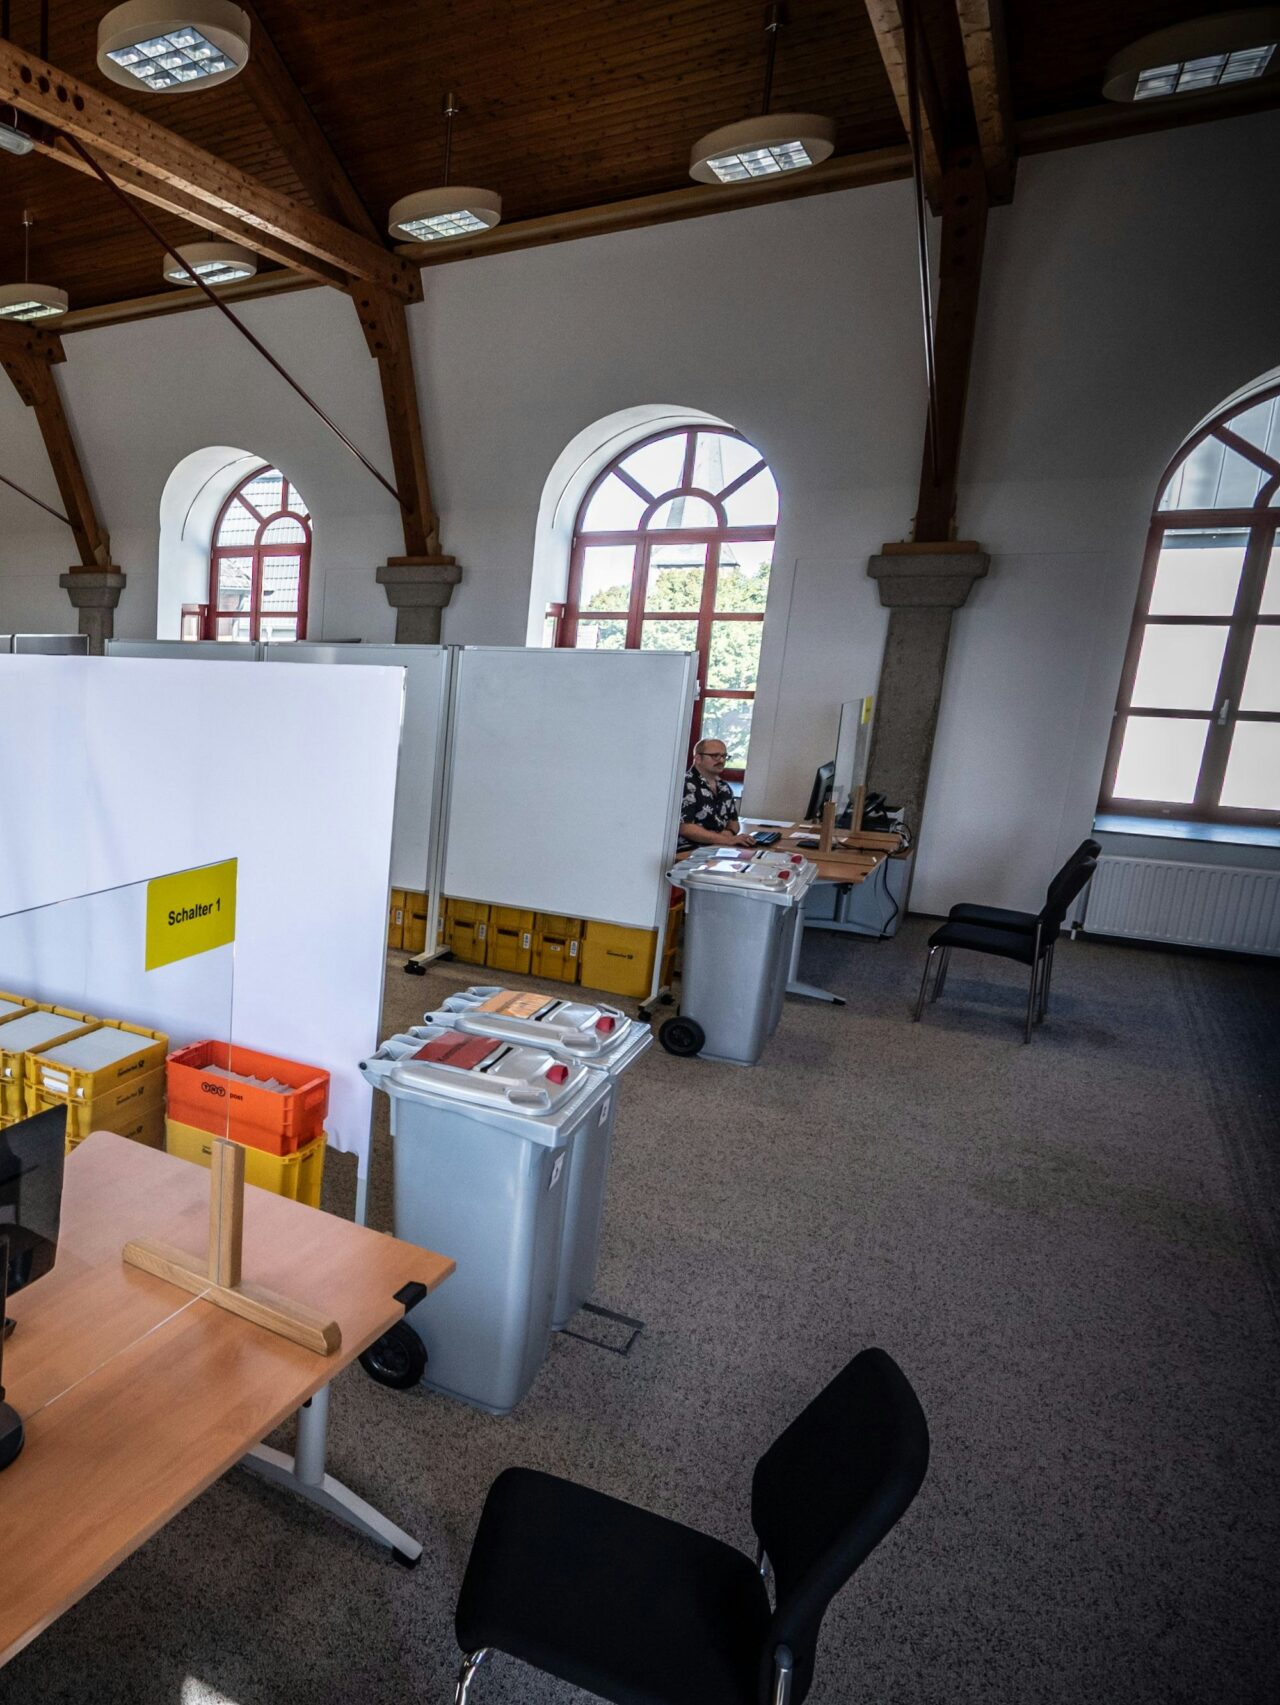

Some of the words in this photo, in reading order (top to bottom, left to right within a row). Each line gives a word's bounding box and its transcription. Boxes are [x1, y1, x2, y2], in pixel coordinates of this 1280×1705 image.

[167, 903, 214, 926] Schalter
[215, 897, 221, 912] 1
[201, 1081, 226, 1098] TNT
